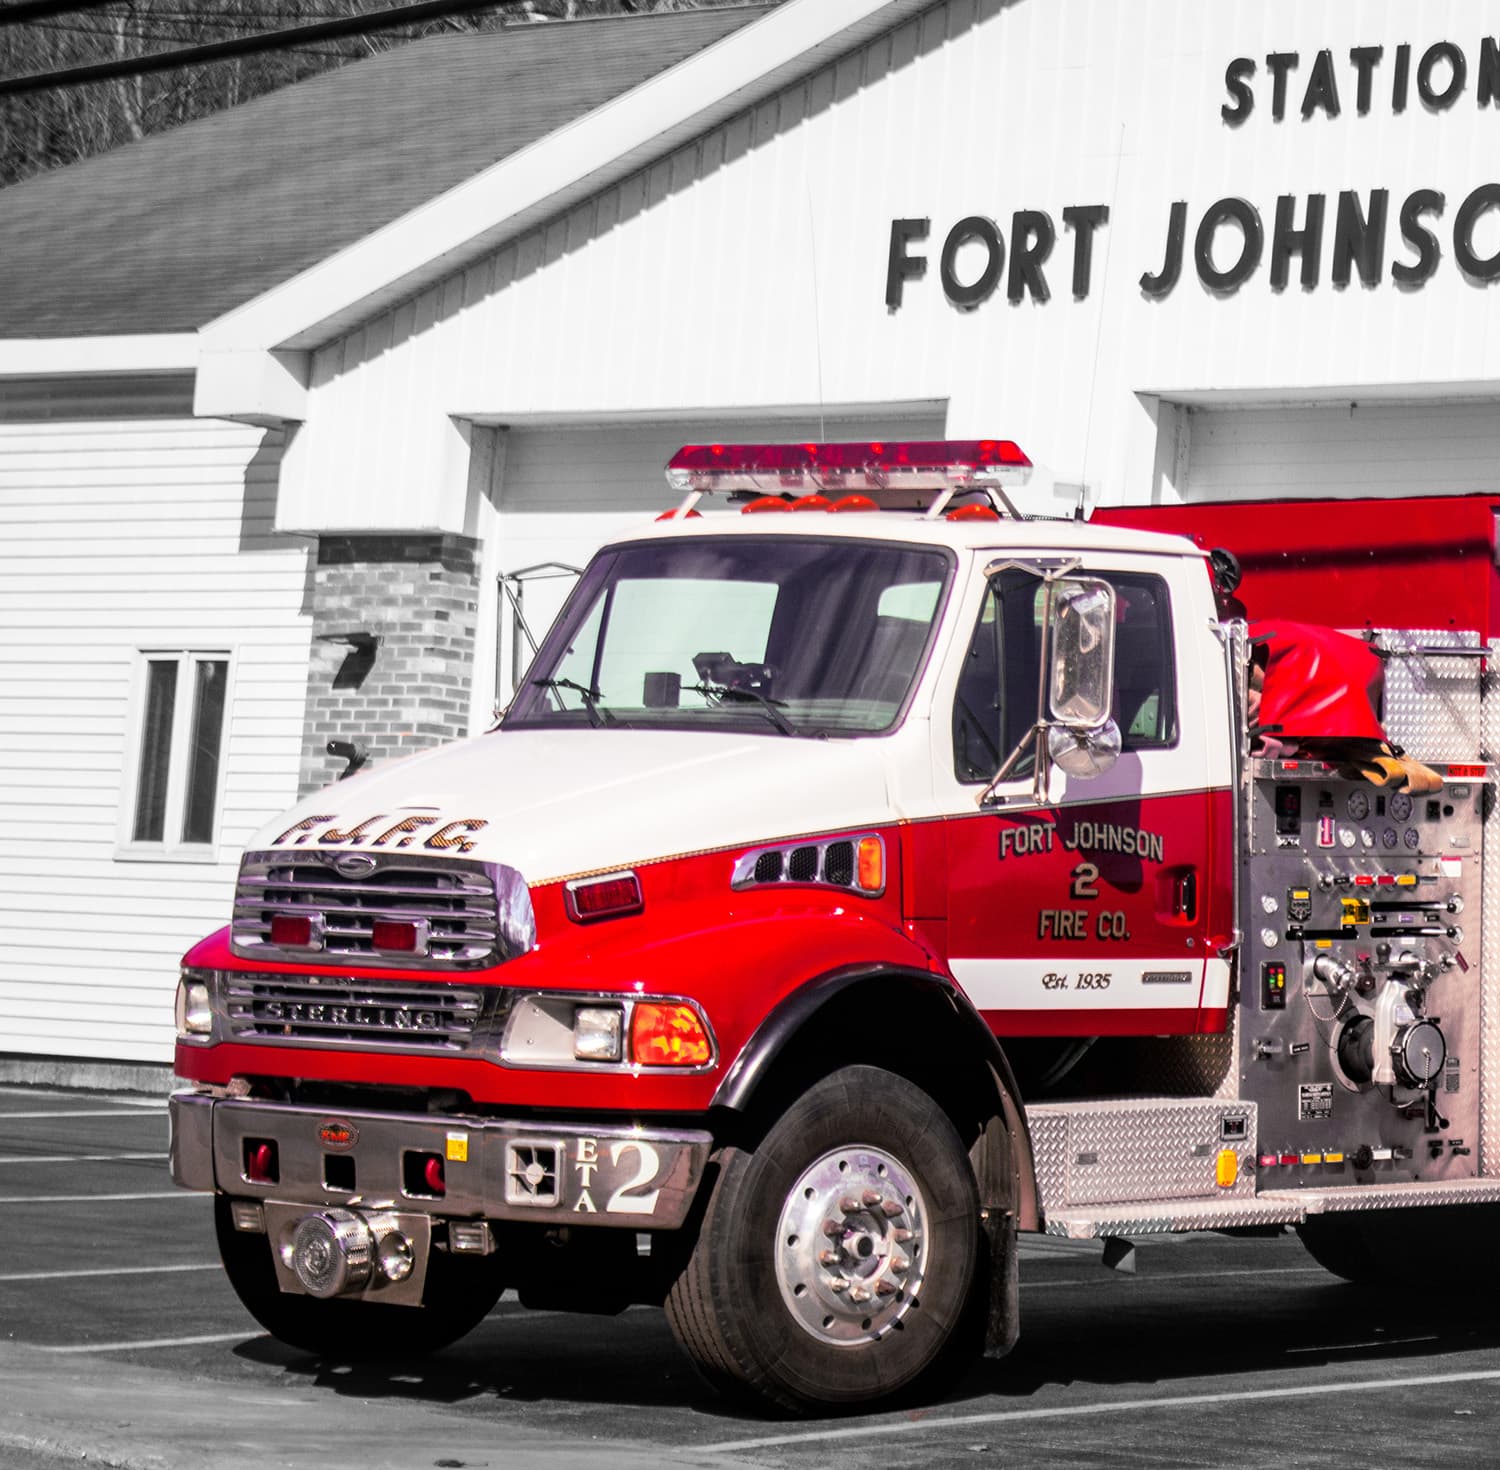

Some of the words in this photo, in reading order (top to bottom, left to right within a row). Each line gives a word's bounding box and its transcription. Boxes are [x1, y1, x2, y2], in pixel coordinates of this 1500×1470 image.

[886, 204, 1110, 312] FORT
[999, 823, 1057, 861] FORT
[1065, 822, 1163, 861] JOHNSON
[1072, 863, 1099, 898] 2
[1039, 911, 1088, 939] FIRE
[1097, 911, 1132, 938] CO.
[1042, 974, 1069, 991] Est.
[1075, 973, 1112, 991] 1935
[265, 1003, 437, 1030] STERLING
[606, 1140, 660, 1214] 2
